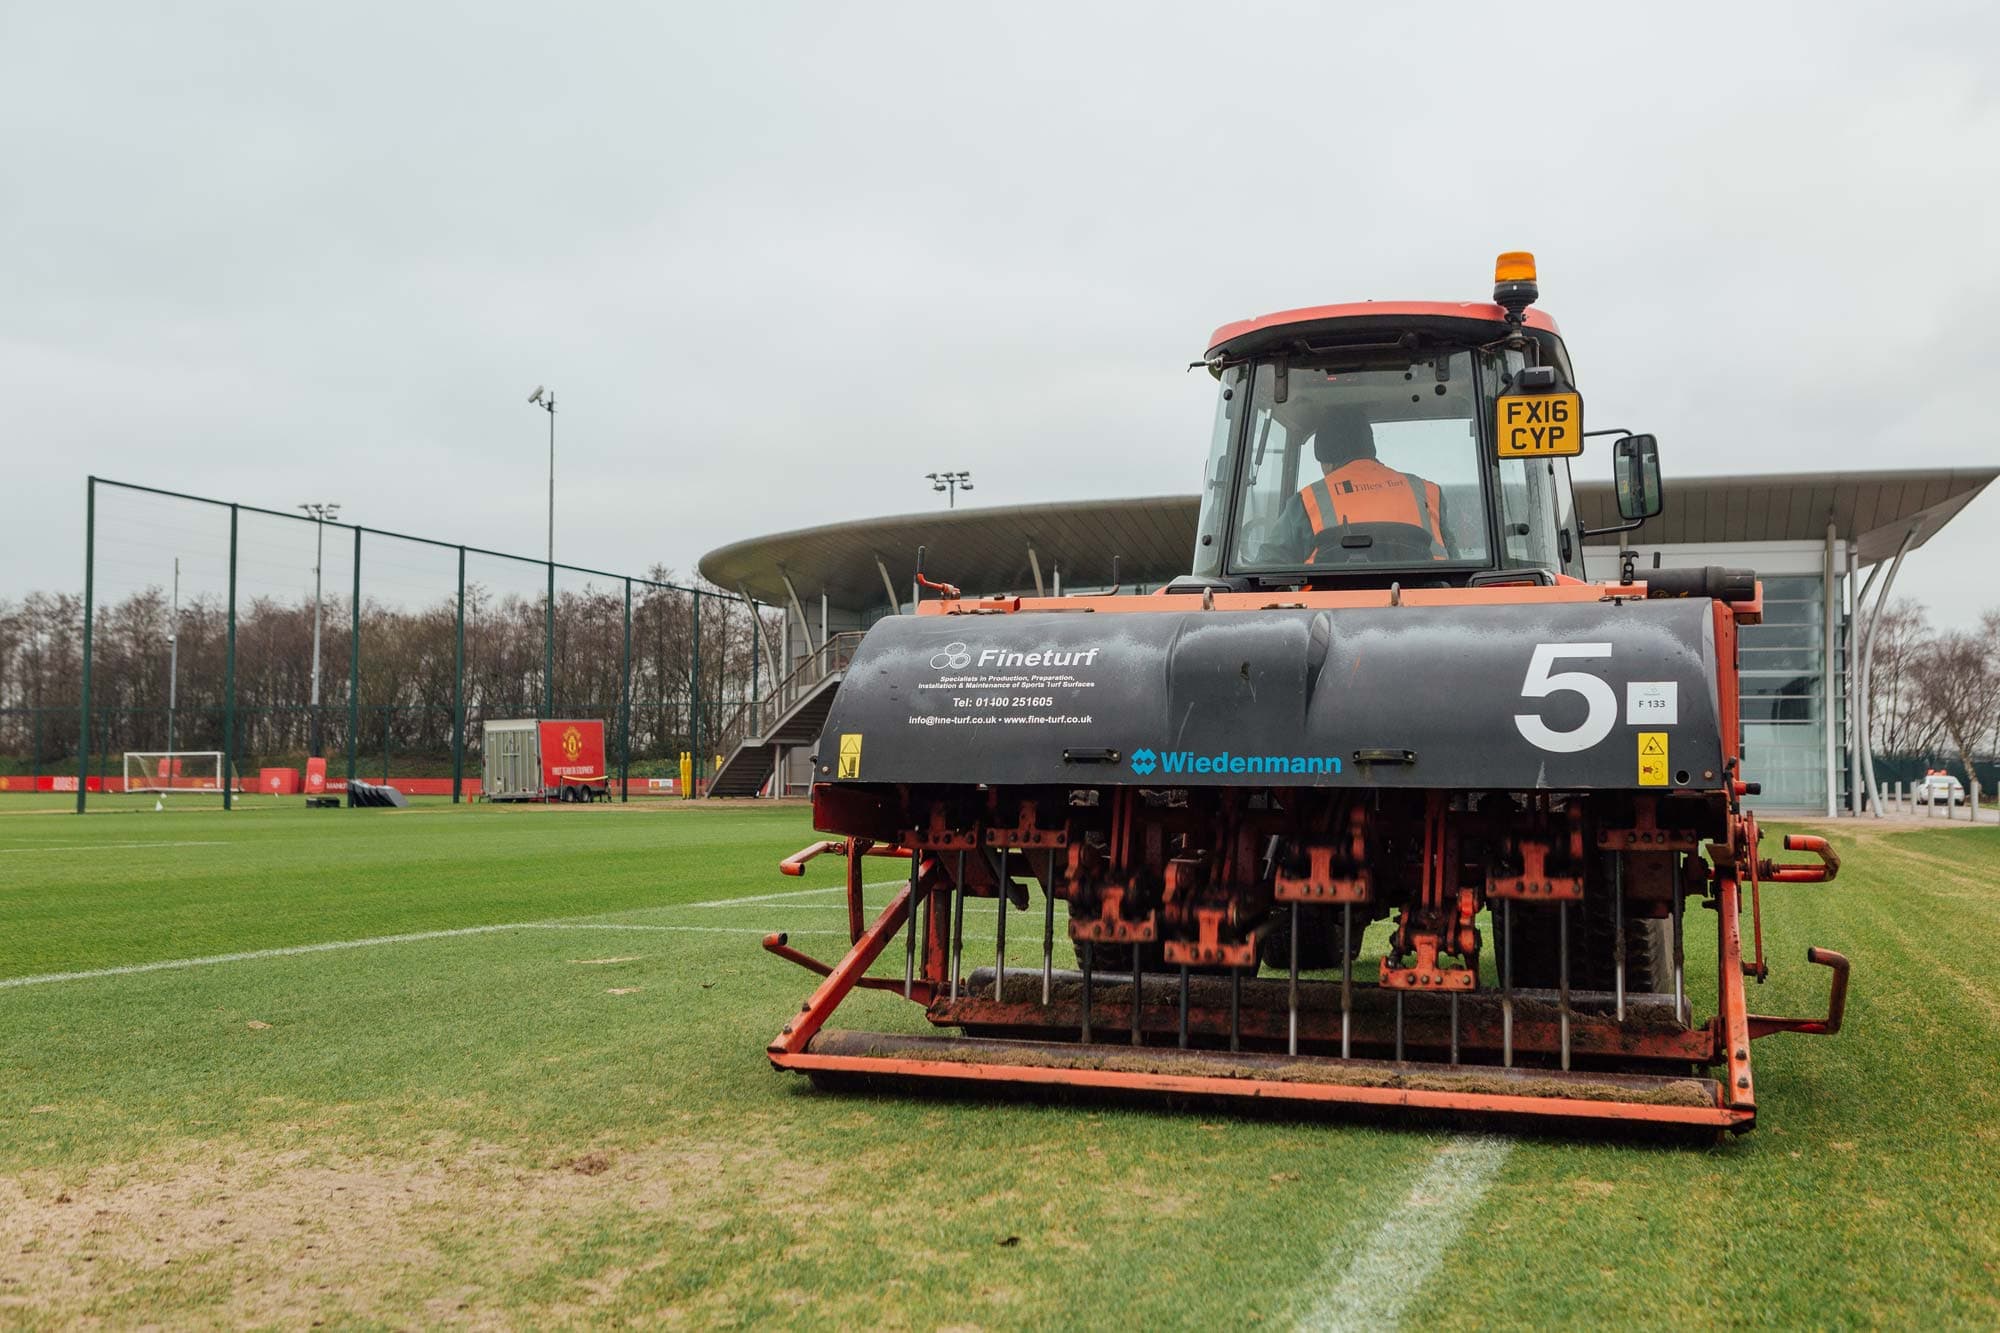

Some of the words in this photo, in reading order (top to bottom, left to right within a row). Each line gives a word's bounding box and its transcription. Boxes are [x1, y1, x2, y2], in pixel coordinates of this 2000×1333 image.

[1507, 400, 1568, 424] FX16
[1511, 426, 1564, 450] CYP
[977, 648, 1100, 667] Fineturf
[953, 697, 973, 707] Tel:
[975, 697, 1009, 707] 01400
[1012, 696, 1054, 707] 251605
[1514, 643, 1618, 753] 5
[1638, 700, 1644, 708] F
[1648, 700, 1666, 708] 133
[1003, 715, 1093, 724] www.fine-turf.co.uk
[1160, 751, 1342, 774] Wiedenmann
